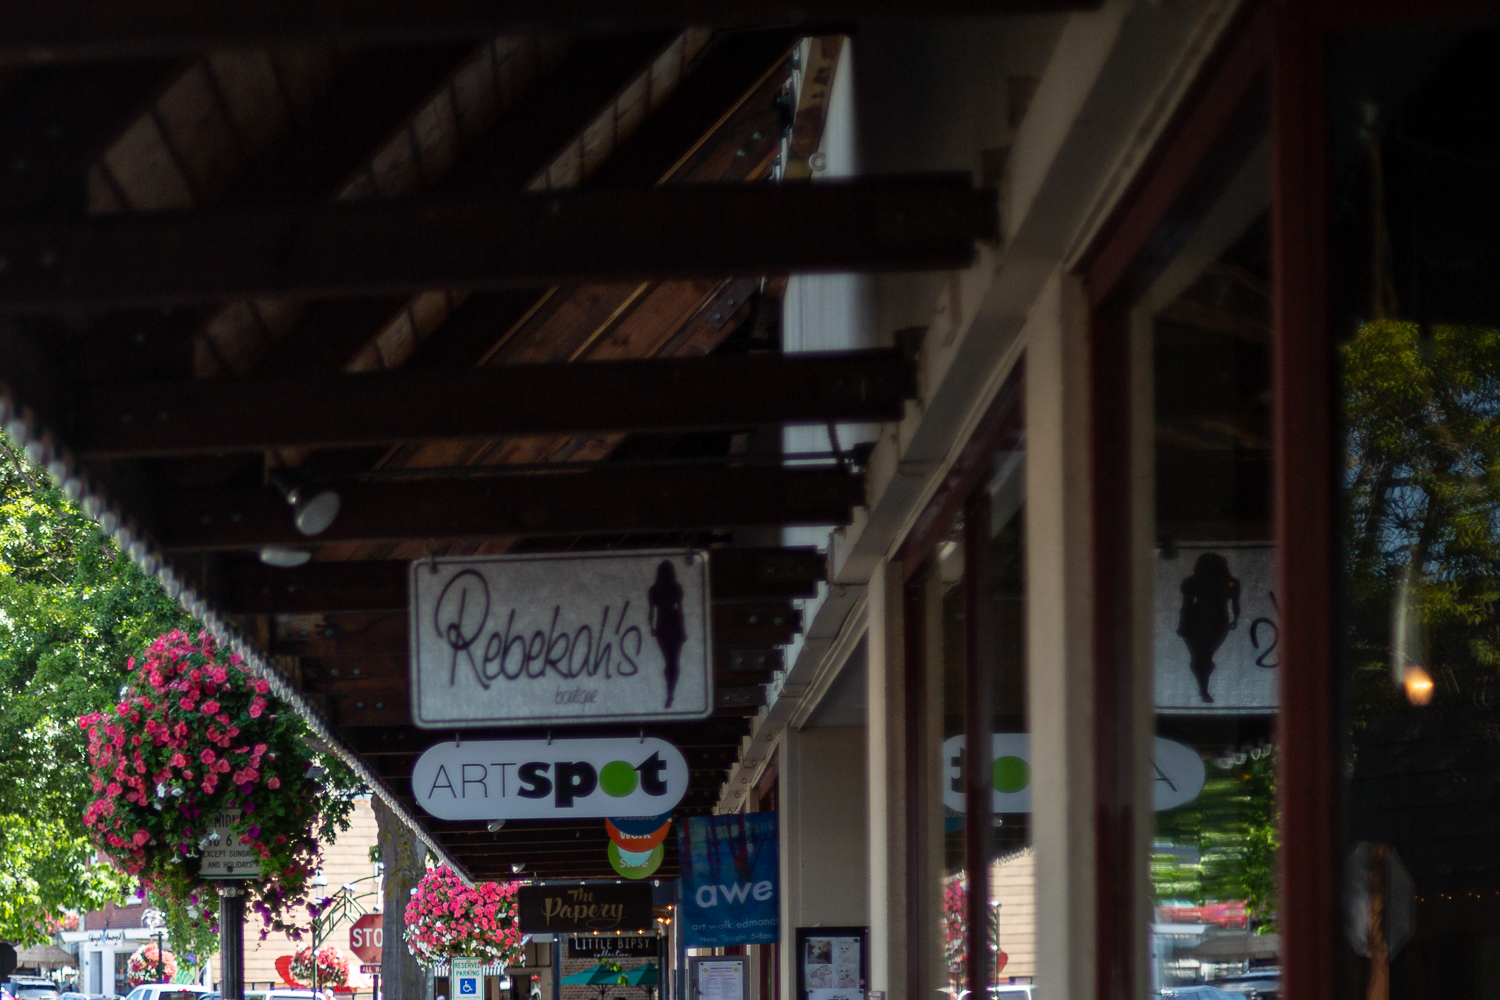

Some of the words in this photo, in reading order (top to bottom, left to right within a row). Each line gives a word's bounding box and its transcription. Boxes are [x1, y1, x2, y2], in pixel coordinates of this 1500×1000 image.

[434, 568, 643, 691] Rebekah's
[226, 834, 233, 847] 6
[203, 850, 227, 858] EXCEPT
[228, 850, 253, 858] SUNDA
[208, 861, 220, 869] AND
[223, 861, 253, 869] HOLIDAYS
[619, 858, 649, 868] Ste
[567, 888, 595, 903] The
[695, 879, 774, 908] awe
[542, 897, 627, 929] Papery
[692, 923, 706, 931] art
[709, 920, 732, 930] walk
[352, 928, 383, 948] STO
[574, 938, 613, 950] LITTLE
[617, 938, 650, 949] BIPSY
[454, 961, 482, 969] RESERVED
